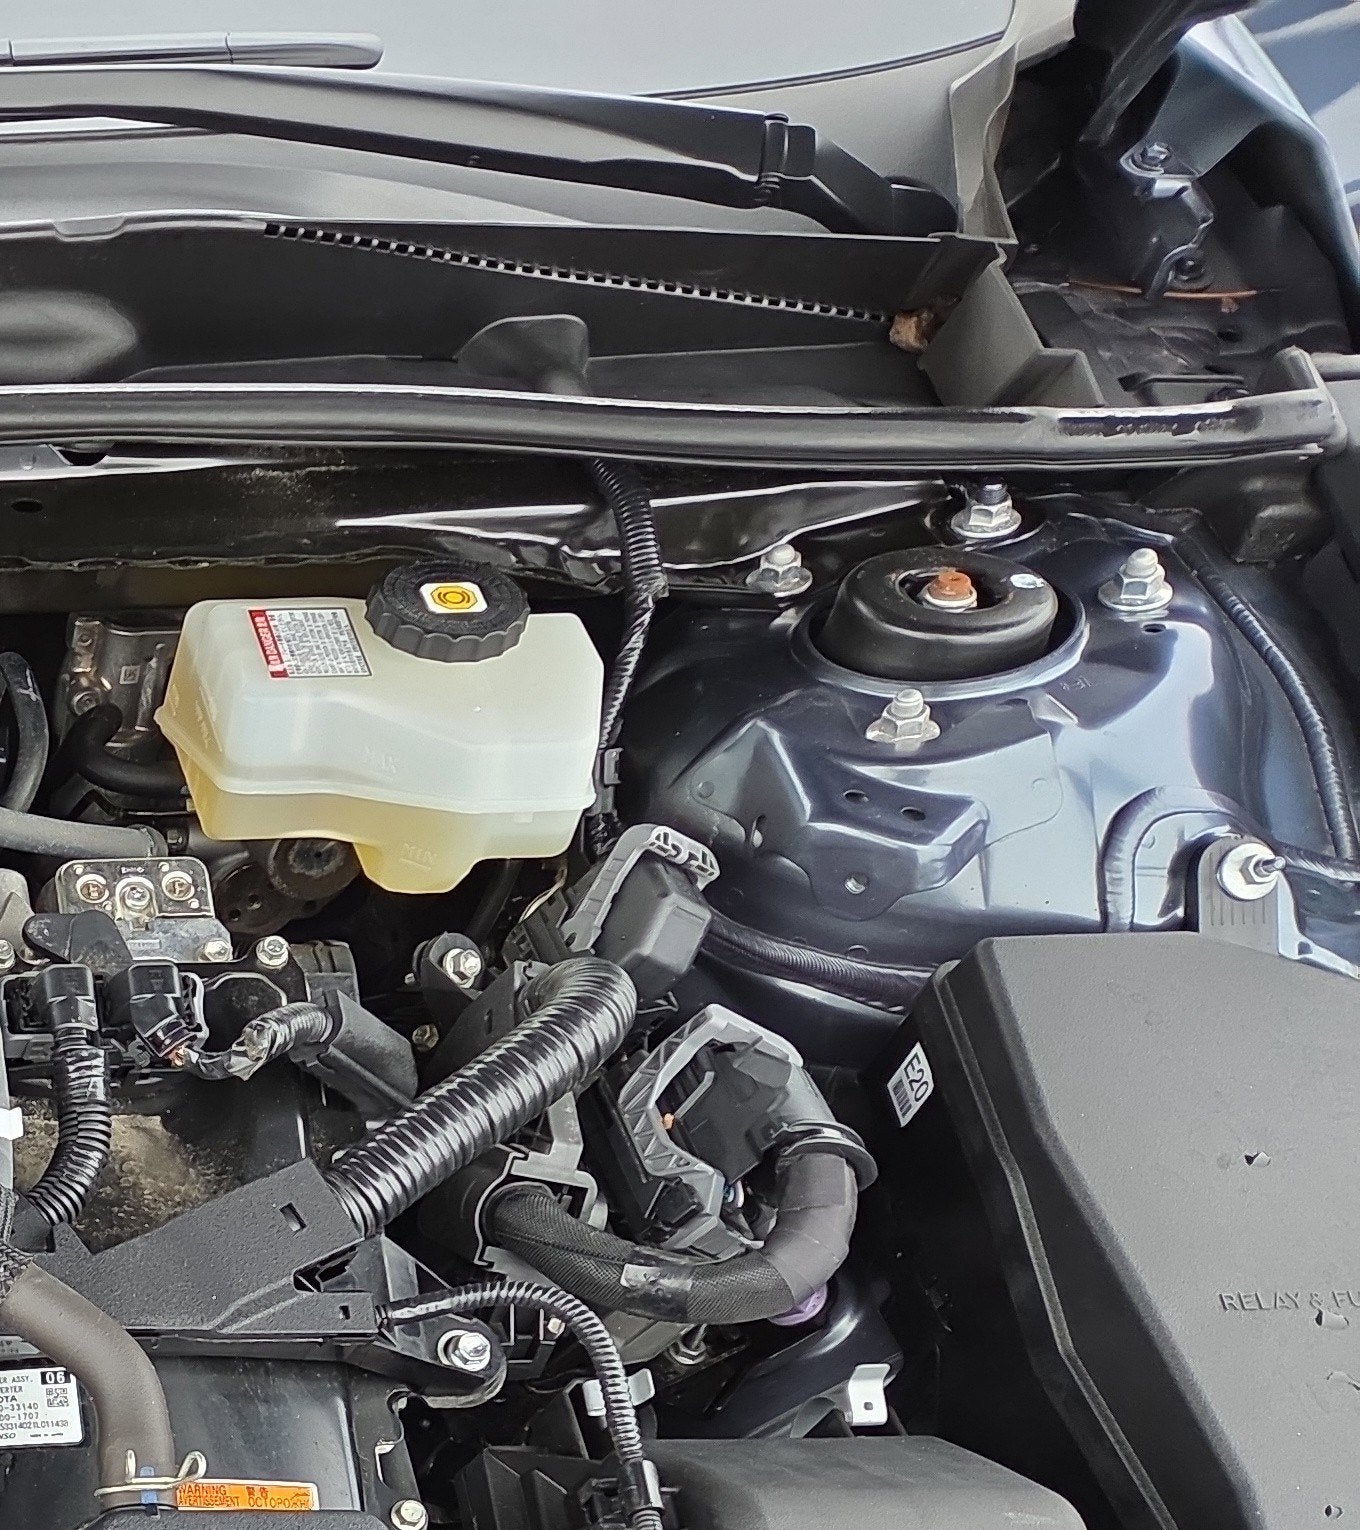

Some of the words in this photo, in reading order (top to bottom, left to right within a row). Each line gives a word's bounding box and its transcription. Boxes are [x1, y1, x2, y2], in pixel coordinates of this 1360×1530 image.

[902, 1053, 929, 1103] E20
[1218, 1291, 1300, 1312] RELAY
[1331, 1289, 1360, 1309] FU
[11, 1375, 34, 1384] ASSY.
[45, 1371, 66, 1384] 06
[179, 1484, 227, 1496] WARNING
